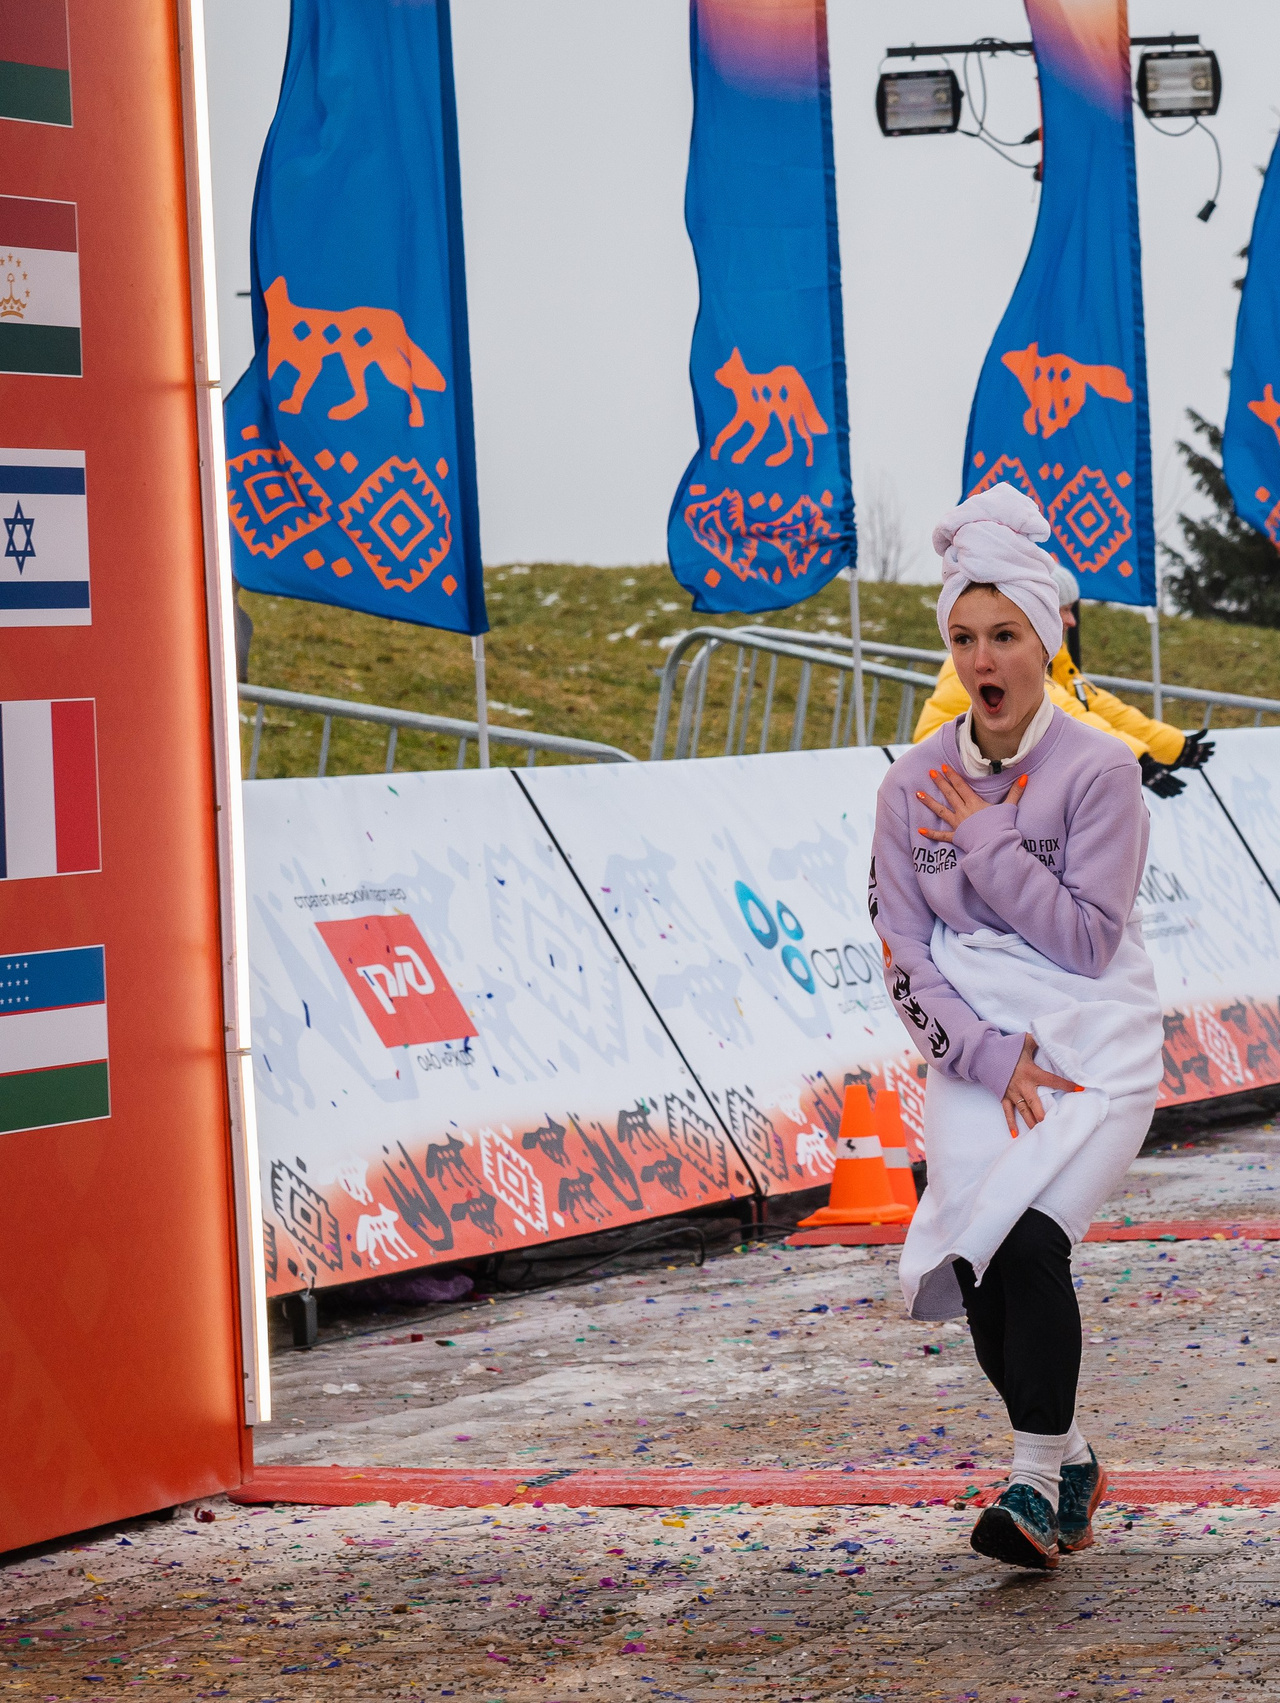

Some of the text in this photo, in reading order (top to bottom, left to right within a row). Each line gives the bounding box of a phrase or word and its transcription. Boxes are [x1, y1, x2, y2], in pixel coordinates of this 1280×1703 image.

[1022, 838, 1060, 853] AD FOX
[811, 943, 884, 989] OZON
